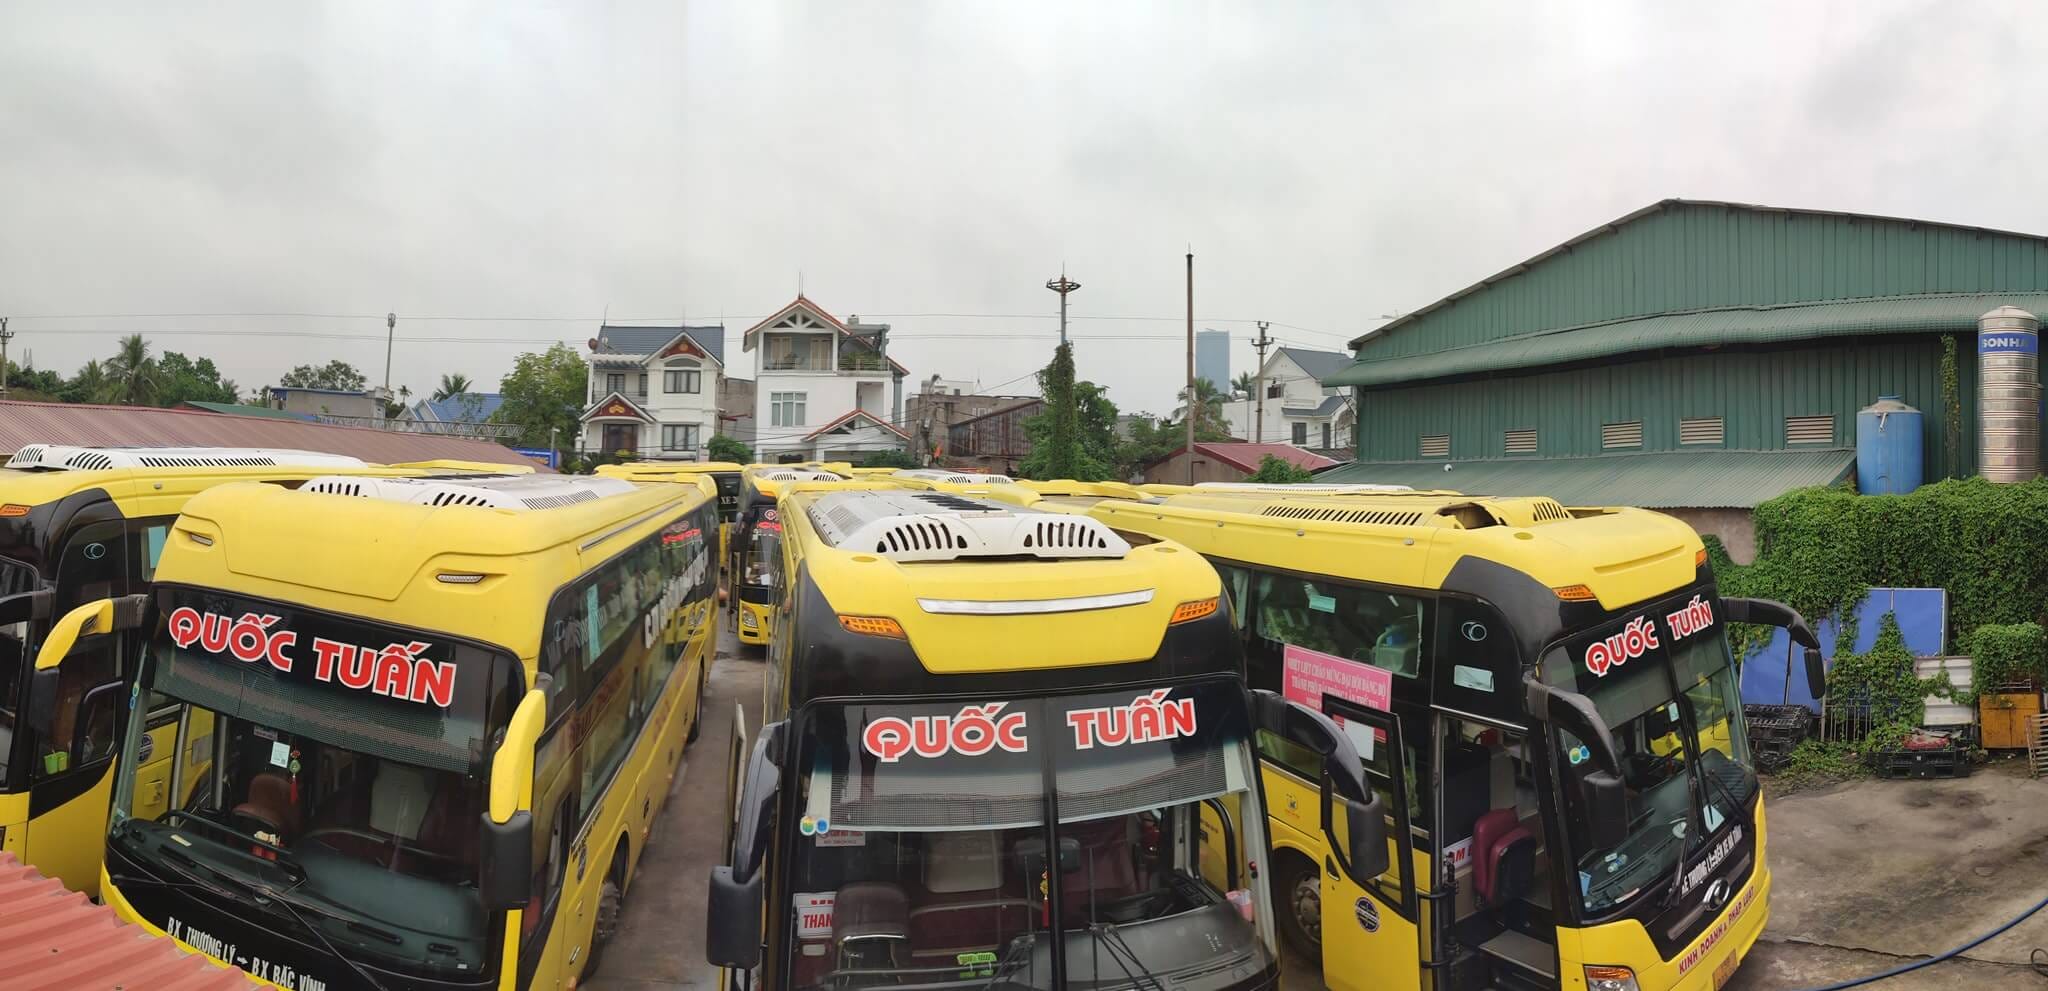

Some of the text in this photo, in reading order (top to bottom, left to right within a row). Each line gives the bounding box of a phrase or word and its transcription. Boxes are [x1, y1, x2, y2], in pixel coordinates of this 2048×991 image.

[169, 607, 457, 707] QUỐC TUẤN
[1585, 594, 1714, 677] QUỐC TUẤN
[863, 687, 1197, 762] QUỐC TUẤN
[167, 916, 182, 939] BX
[223, 943, 236, 965] LÝ
[252, 957, 269, 981] BX
[273, 964, 295, 989] BẮC
[1679, 948, 1698, 976] KINH
[1700, 923, 1723, 956] DOANH
